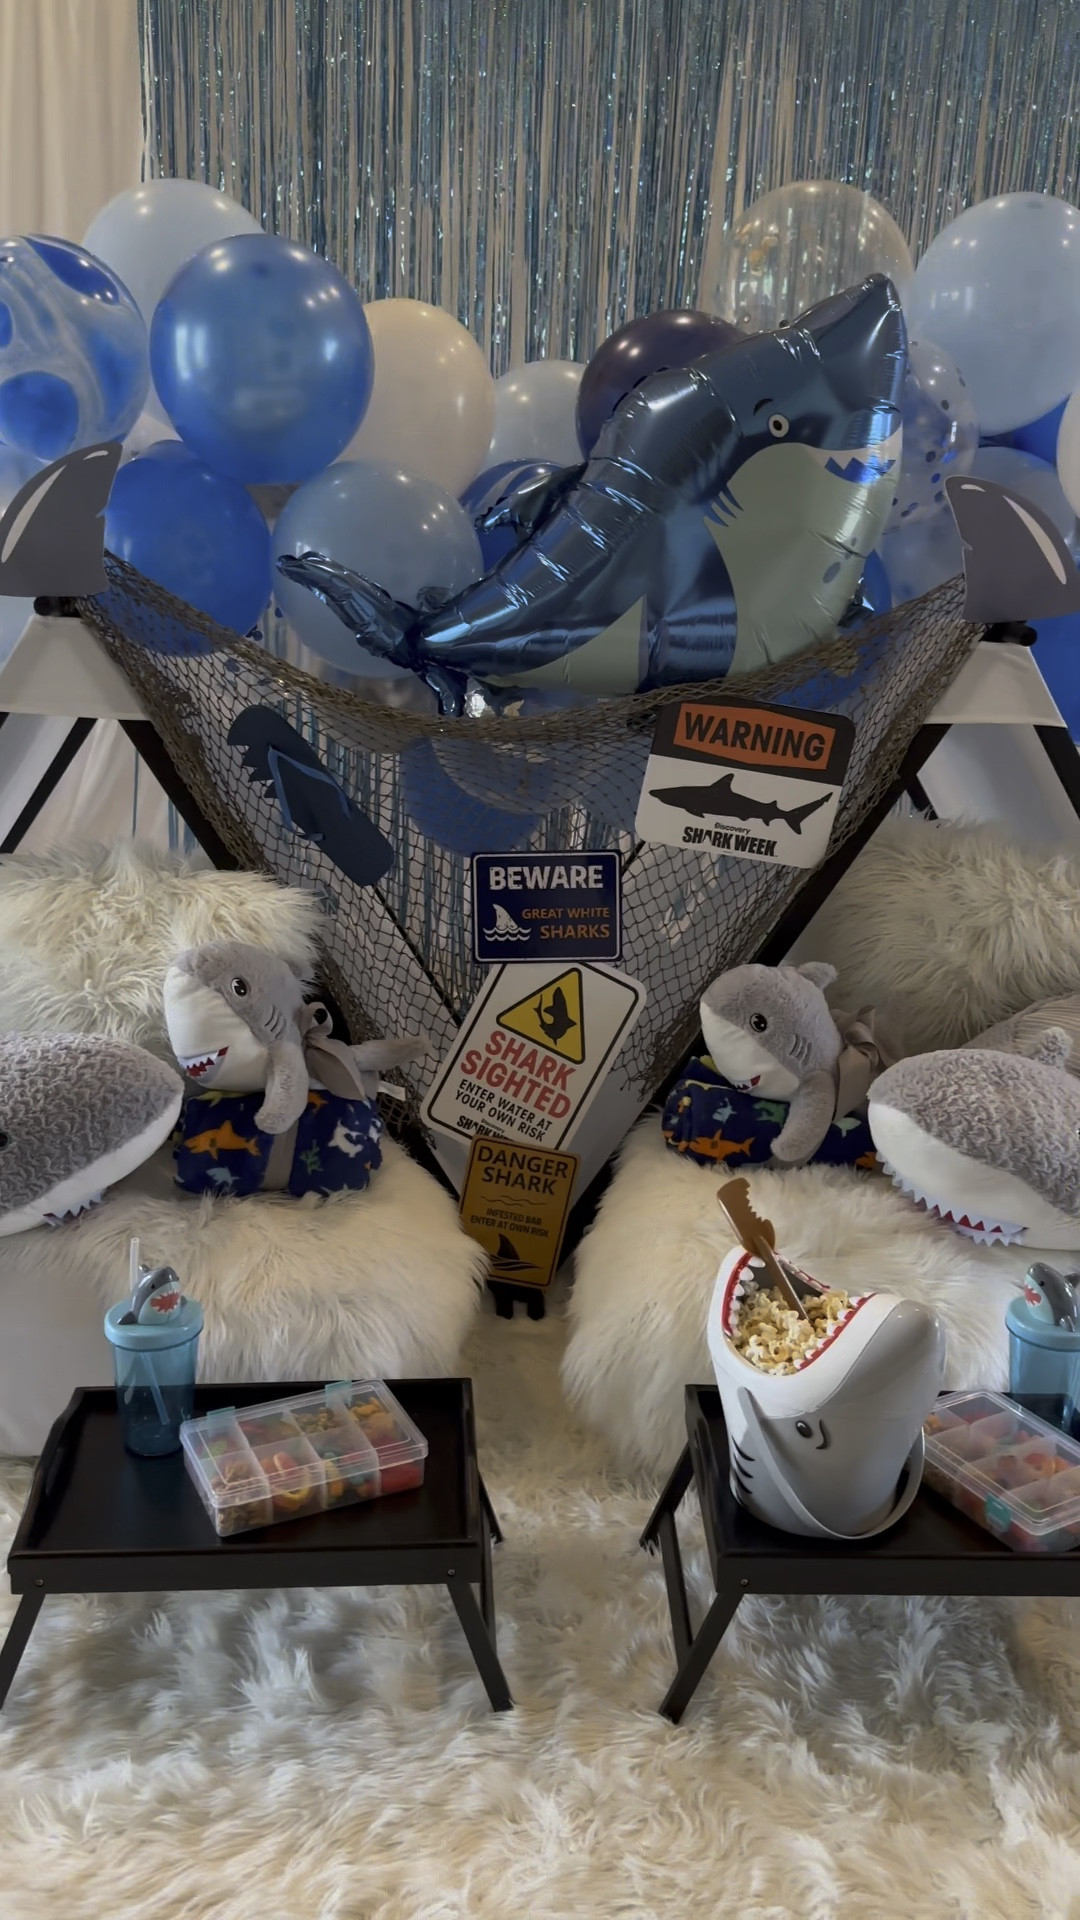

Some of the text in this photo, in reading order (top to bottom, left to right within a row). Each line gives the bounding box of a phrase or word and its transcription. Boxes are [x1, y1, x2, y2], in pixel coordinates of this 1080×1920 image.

[685, 711, 826, 761] WARNING
[682, 826, 777, 857] SHARK WEEK
[714, 822, 751, 835] Discovery
[489, 865, 604, 890] BEWARE
[522, 907, 610, 919] GREAT WHITE
[540, 924, 610, 939] SHARKS
[485, 1030, 577, 1091] SHARK
[461, 1050, 571, 1119] SIGHTED
[455, 1090, 486, 1112] YOUR
[488, 1107, 516, 1127] OWN
[517, 1121, 546, 1142] RISK
[459, 1079, 553, 1131] ENTER WATER AT
[477, 1146, 569, 1178] DANGER
[482, 1166, 557, 1195] SHARK
[470, 1214, 550, 1238] ENTER AT OWN RISK
[486, 1208, 525, 1222] INFESTED
